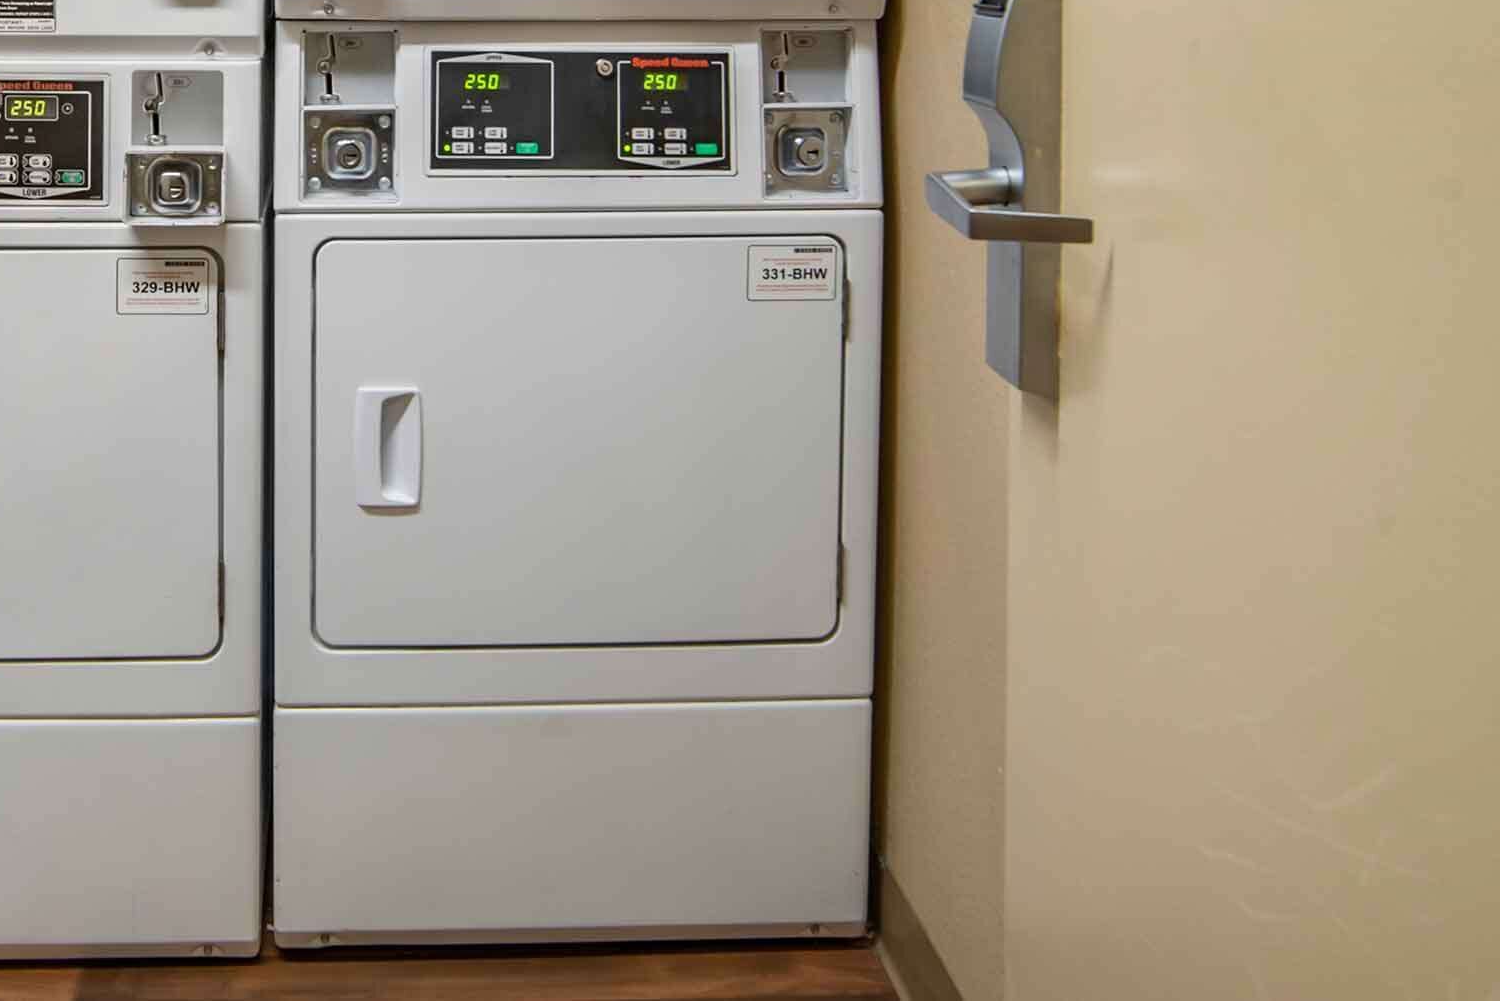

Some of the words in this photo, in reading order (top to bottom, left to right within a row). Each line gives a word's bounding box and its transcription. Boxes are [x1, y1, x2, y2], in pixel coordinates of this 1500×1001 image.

[22, 188, 47, 196] LOWER
[762, 268, 828, 280] 331-BHW
[132, 281, 200, 293] 329-BHW
